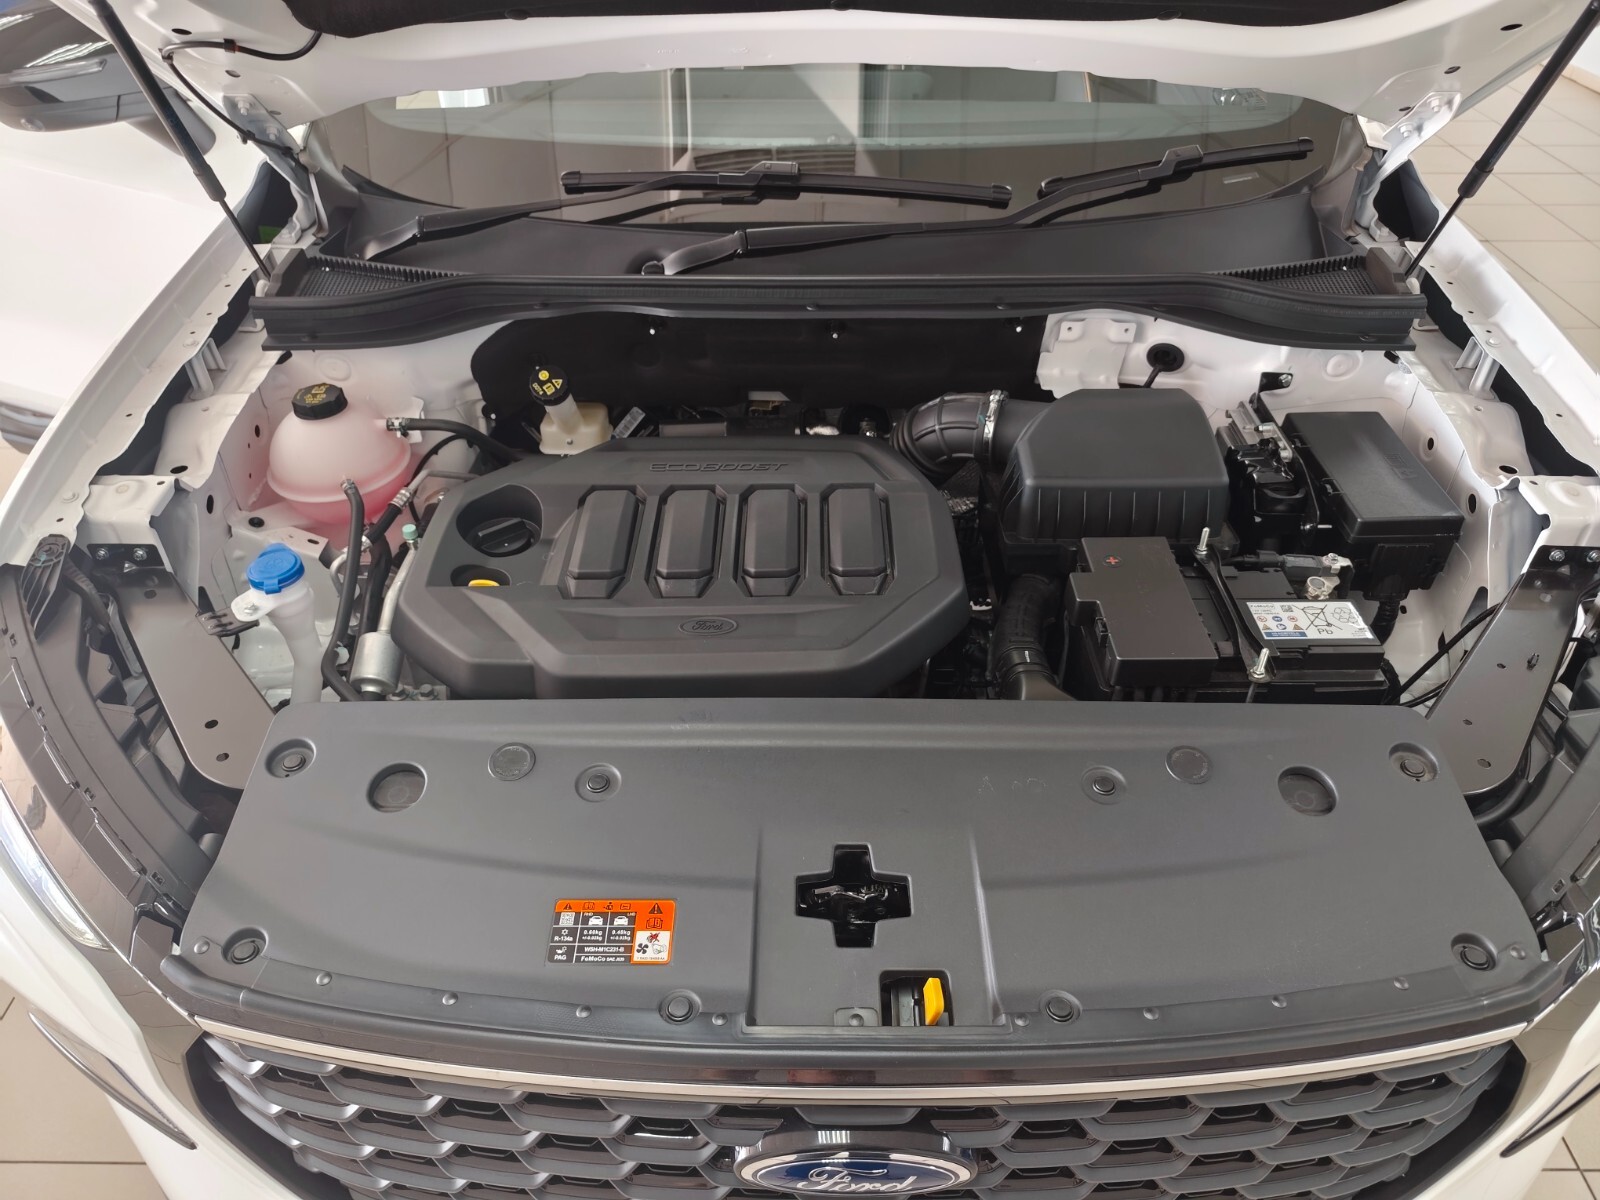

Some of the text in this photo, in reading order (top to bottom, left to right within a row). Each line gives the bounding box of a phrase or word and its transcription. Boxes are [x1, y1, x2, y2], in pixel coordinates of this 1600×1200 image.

[650, 463, 789, 472] ECOBOOST
[692, 620, 724, 631] Ford
[796, 1165, 918, 1192] Ford
